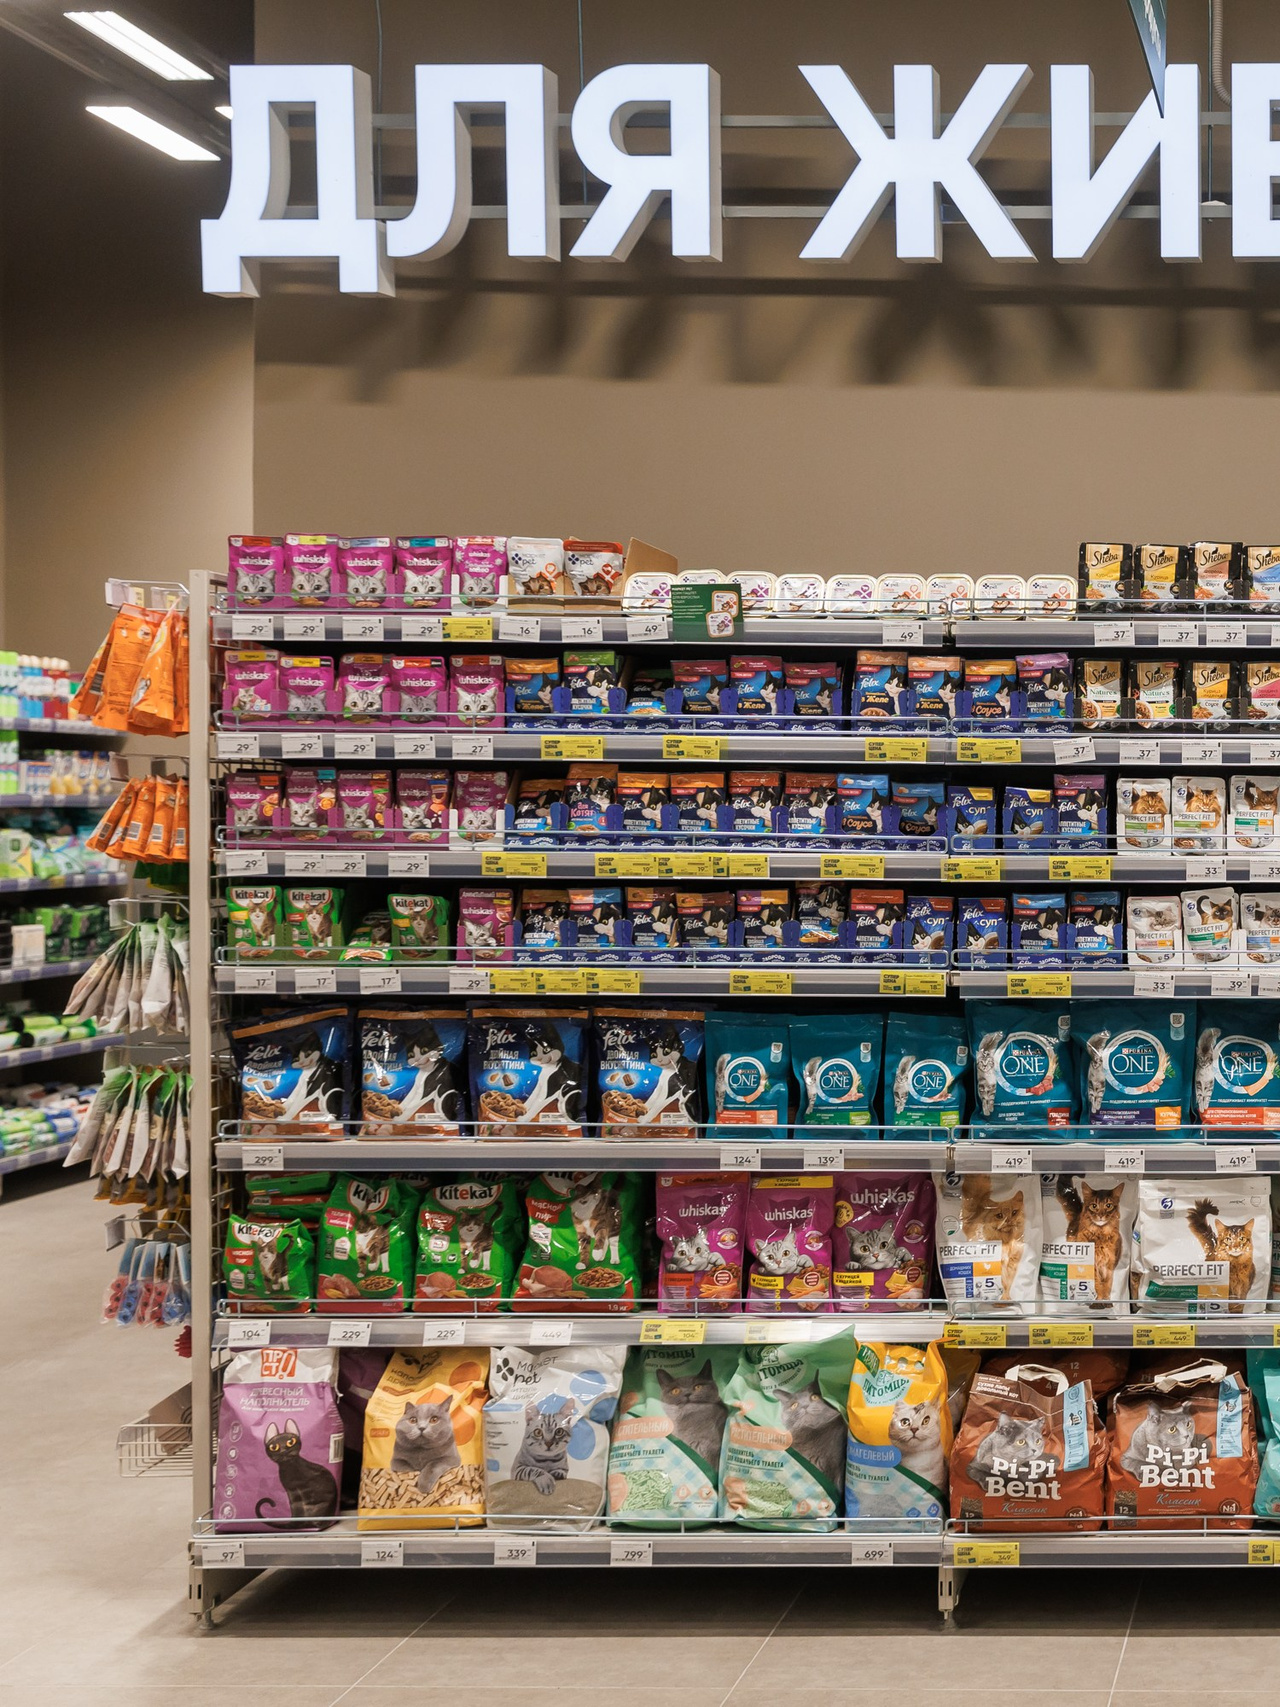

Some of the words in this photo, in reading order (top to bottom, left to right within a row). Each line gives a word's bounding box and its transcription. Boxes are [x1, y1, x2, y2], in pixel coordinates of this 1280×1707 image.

[201, 64, 715, 295] ДЛЯ
[293, 555, 328, 564] whiskas
[1094, 547, 1119, 567] Sheba
[1149, 549, 1174, 569] Sheba
[1200, 547, 1228, 566] Sheba
[239, 557, 274, 567] whiskas
[347, 558, 382, 567] whiskas
[252, 626, 264, 634] 29
[645, 624, 658, 634] 49
[1114, 630, 1126, 638] 37
[1200, 666, 1226, 686] Sheba
[1254, 666, 1280, 686] Sheba
[289, 677, 324, 686] whiskas
[401, 679, 436, 688] whiskas
[860, 678, 880, 690] felix
[237, 744, 249, 752] 29
[952, 796, 972, 808] felix
[1058, 802, 1078, 813] felix
[235, 889, 270, 899] kitekat
[292, 890, 326, 901] kitekat
[963, 907, 984, 918] felix
[856, 916, 876, 928] felix
[1230, 981, 1242, 990] 39
[486, 1028, 516, 1050] felix
[604, 1030, 636, 1050] felix
[1112, 1054, 1156, 1074] ONE
[255, 1156, 274, 1164] 299
[734, 1156, 752, 1164] 124
[818, 1156, 834, 1164] 139
[1006, 1158, 1023, 1166] 419
[1118, 1158, 1136, 1166] 419
[1230, 1156, 1246, 1165] 419
[440, 1186, 494, 1200] kitekat
[850, 1188, 915, 1204] whiskas
[679, 1205, 725, 1218] whiskas
[764, 1208, 814, 1222] whiskas
[1154, 1264, 1204, 1276] PERFECT
[1207, 1264, 1224, 1276] FIT
[242, 1330, 260, 1338] 104
[342, 1330, 360, 1339] 229
[436, 1330, 456, 1338] 229
[251, 1387, 304, 1397] ДРЕВЕСНЫЙ
[864, 1378, 910, 1398] ПИТОМЦЫ
[240, 1397, 310, 1406] НАПОЛНИТЕЛЬ
[1146, 1443, 1209, 1465] Pi-Pi
[991, 1457, 1056, 1479] Pi-Pi
[1139, 1464, 1216, 1490] Bent
[986, 1477, 1062, 1500] Bent
[1156, 1493, 1201, 1506] Классик
[1002, 1502, 1048, 1515] Классик
[222, 1552, 234, 1560] 97
[376, 1550, 394, 1559] 124
[507, 1550, 526, 1558] 339
[624, 1550, 643, 1559] 799
[864, 1550, 884, 1558] 699
